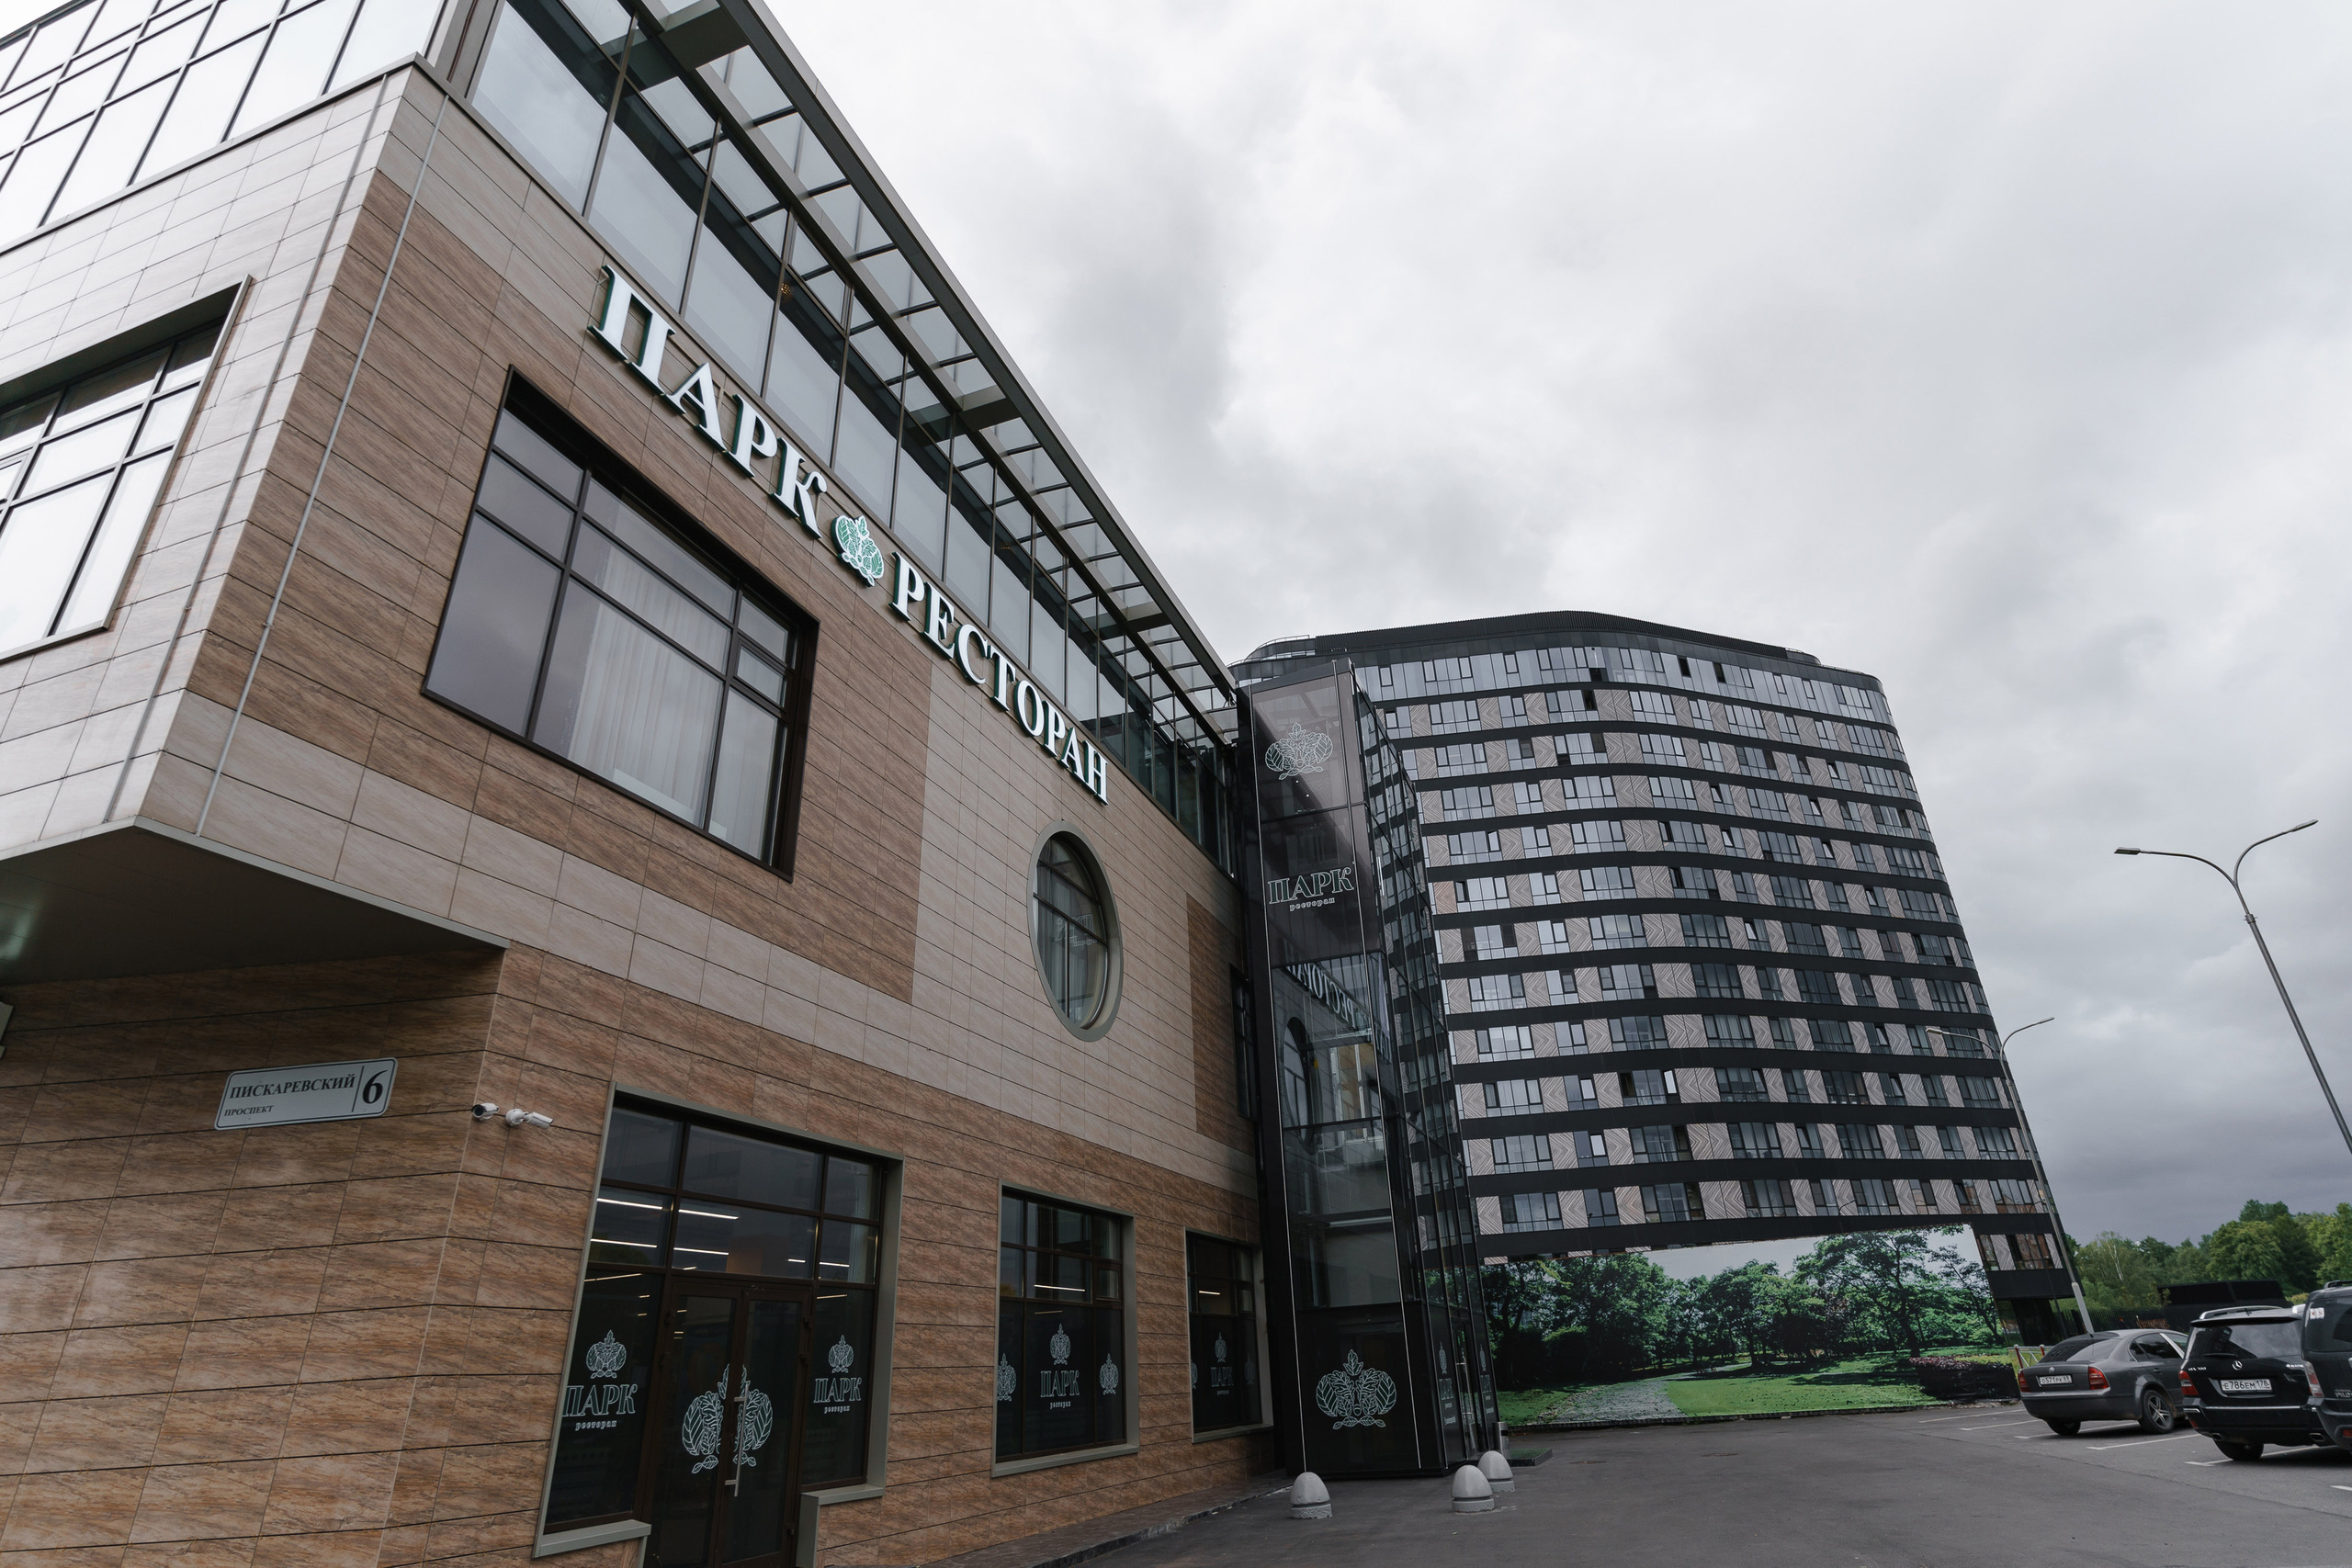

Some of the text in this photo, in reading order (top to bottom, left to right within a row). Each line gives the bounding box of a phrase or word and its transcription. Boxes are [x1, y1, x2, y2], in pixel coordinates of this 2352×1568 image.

[587, 264, 1109, 806] ПАРК РЕСТОРАН
[1268, 866, 1355, 905] ПАРК
[1289, 897, 1336, 912] ресторан
[229, 1069, 389, 1104] ПИСКАРЕВСКИЙ 6
[224, 1105, 275, 1117] ПРОСПЕКТ
[813, 1377, 863, 1403] ПАРК
[1040, 1370, 1080, 1397] ПАРК
[561, 1383, 638, 1417] ПАРК
[575, 1420, 617, 1431] ресторан
